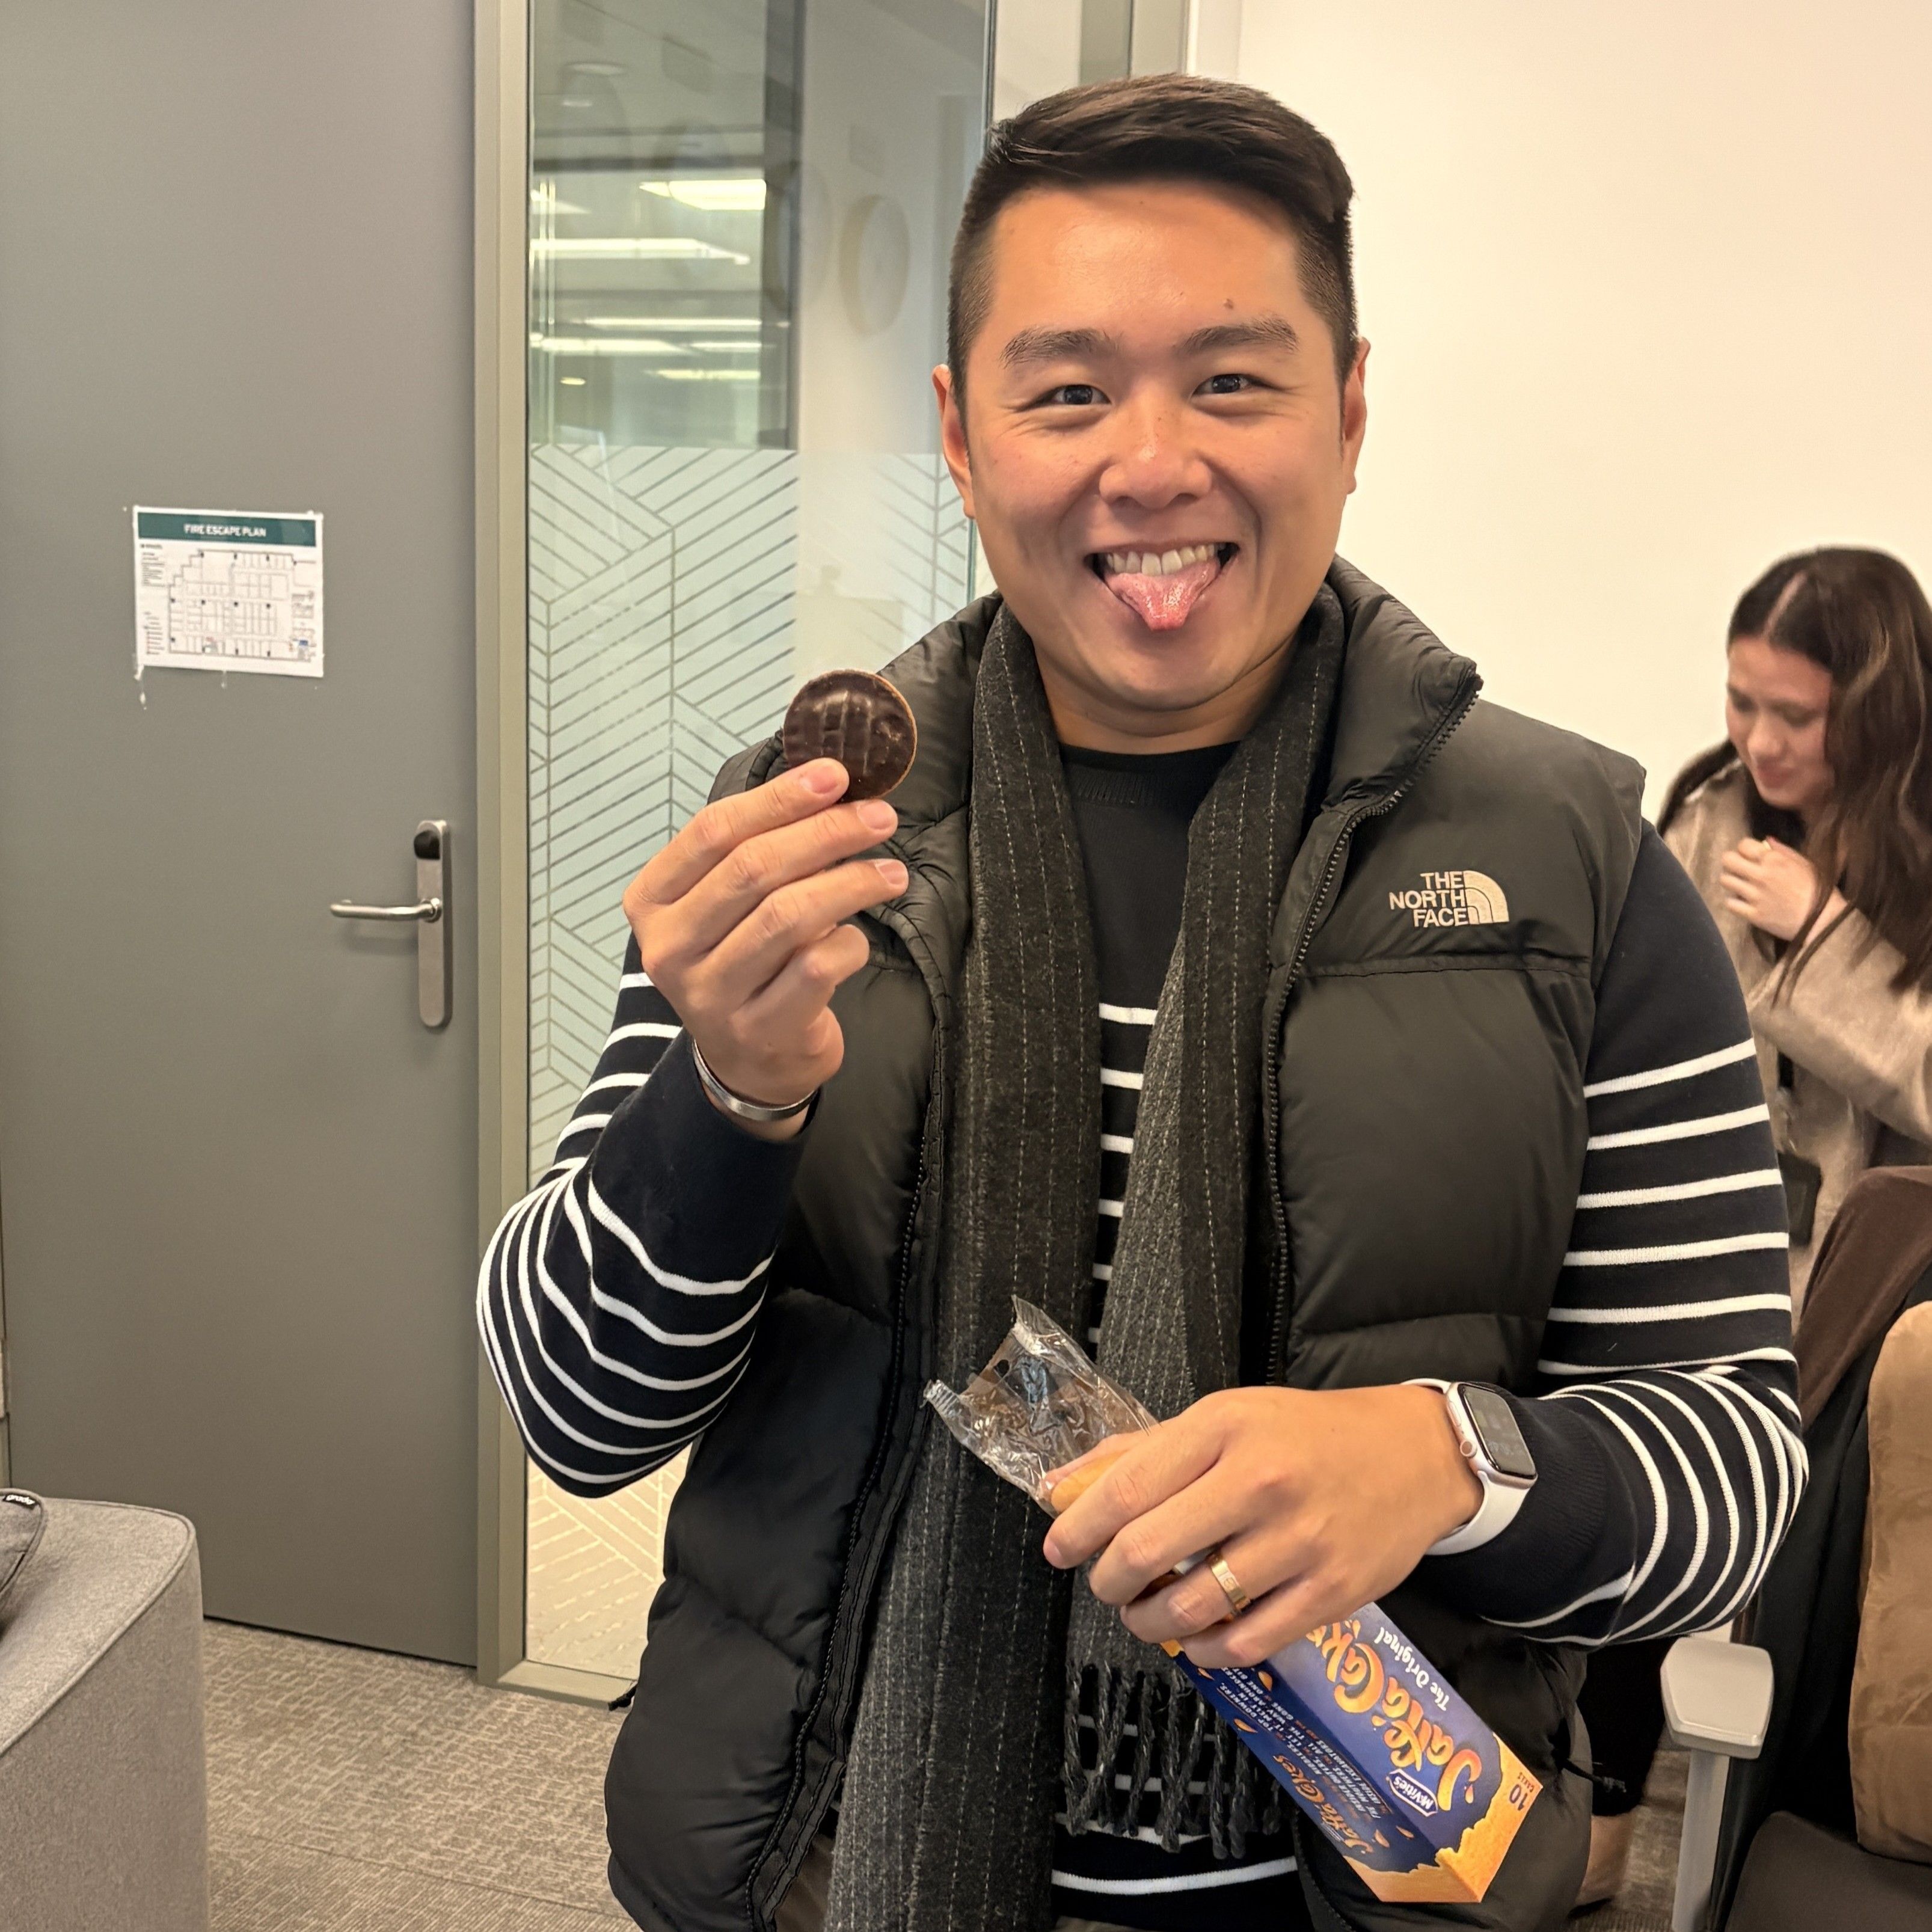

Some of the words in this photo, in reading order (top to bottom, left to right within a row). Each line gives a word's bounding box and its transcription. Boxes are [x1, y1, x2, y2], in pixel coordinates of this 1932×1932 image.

[183, 524, 204, 535] FIRE
[206, 524, 241, 536] ESCAPE
[242, 526, 266, 537] PLAN
[1420, 871, 1464, 890] THE
[1388, 889, 1466, 910] NORTH
[1413, 907, 1469, 928] FACE
[1373, 1626, 1430, 1689] Original
[1238, 1692, 1249, 1701] IN
[1247, 1681, 1263, 1694] ONE
[1429, 1681, 1450, 1712] The
[1219, 1682, 1258, 1718] DOWNERS,
[1250, 1704, 1273, 1722] MELT
[1267, 1709, 1286, 1725] WAY
[1271, 1702, 1294, 1720] GONE
[1258, 1718, 1274, 1732] TOP
[1289, 1726, 1305, 1740] THE
[1286, 1735, 1302, 1746] LET
[1308, 1743, 1323, 1755] ALL
[1382, 1676, 1483, 1811] Jaffa
[1273, 1755, 1325, 1803] Cakes
[1509, 1783, 1529, 1811] 10
[1320, 1803, 1375, 1853] Jaffa
